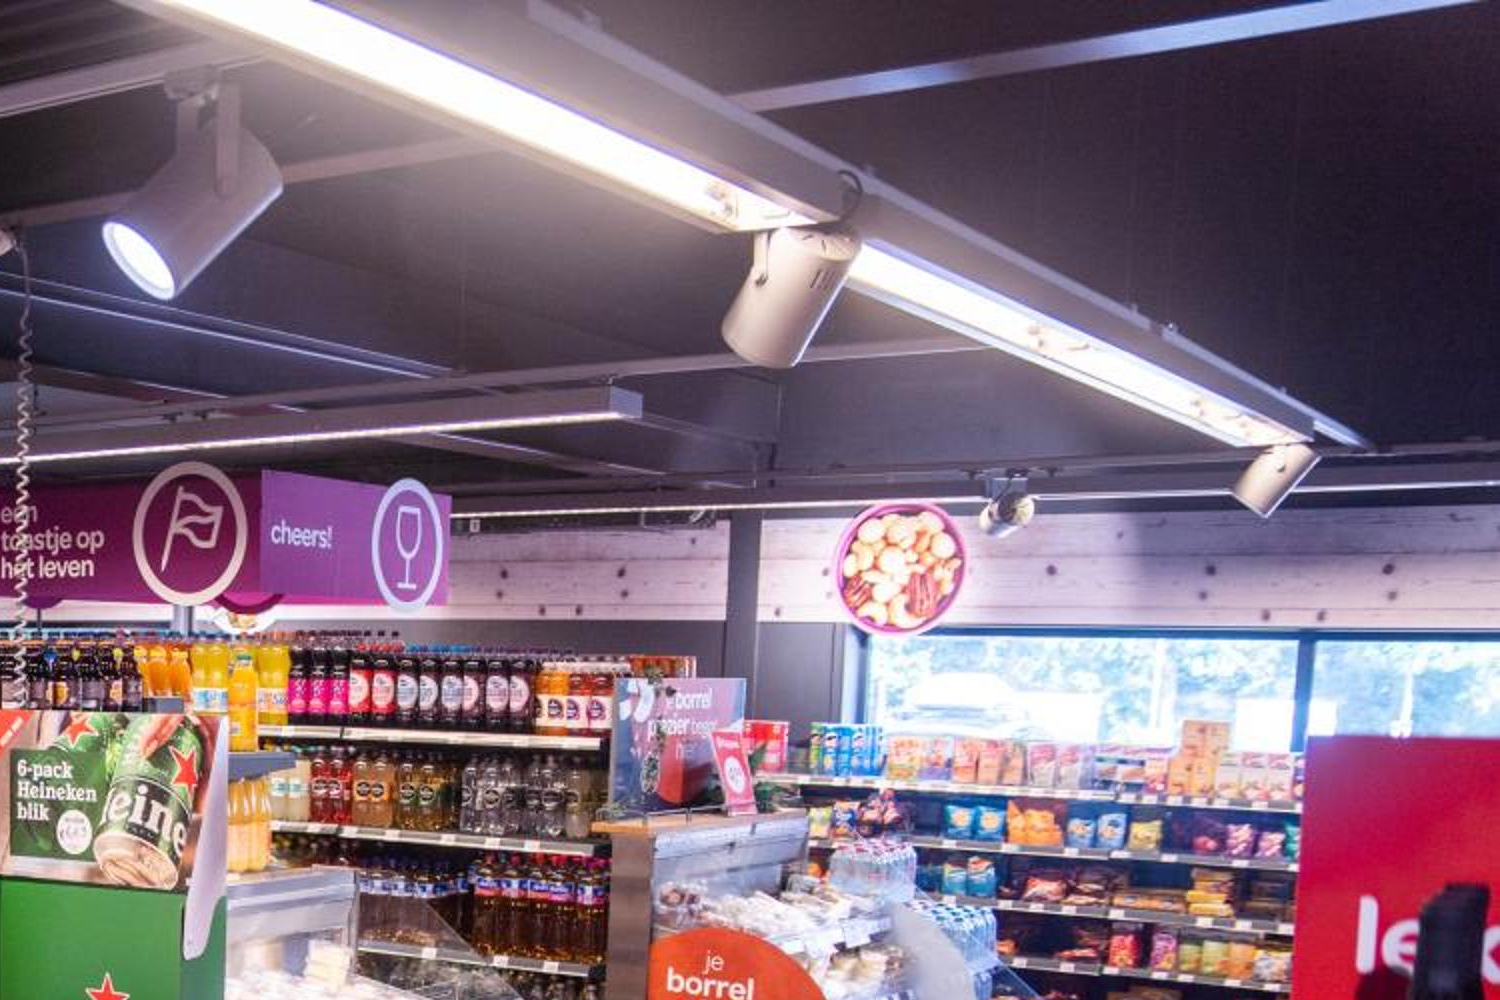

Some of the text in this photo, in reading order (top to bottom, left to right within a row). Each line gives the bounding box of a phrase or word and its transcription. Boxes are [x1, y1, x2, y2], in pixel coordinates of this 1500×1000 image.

[1, 525, 105, 556] toastje op
[271, 519, 332, 549] cheers!
[1, 555, 95, 579] het leven
[16, 759, 74, 780] 6-pack
[16, 780, 98, 803] Heineken
[16, 802, 50, 822] blik
[106, 784, 188, 859] eine
[702, 950, 725, 975] je
